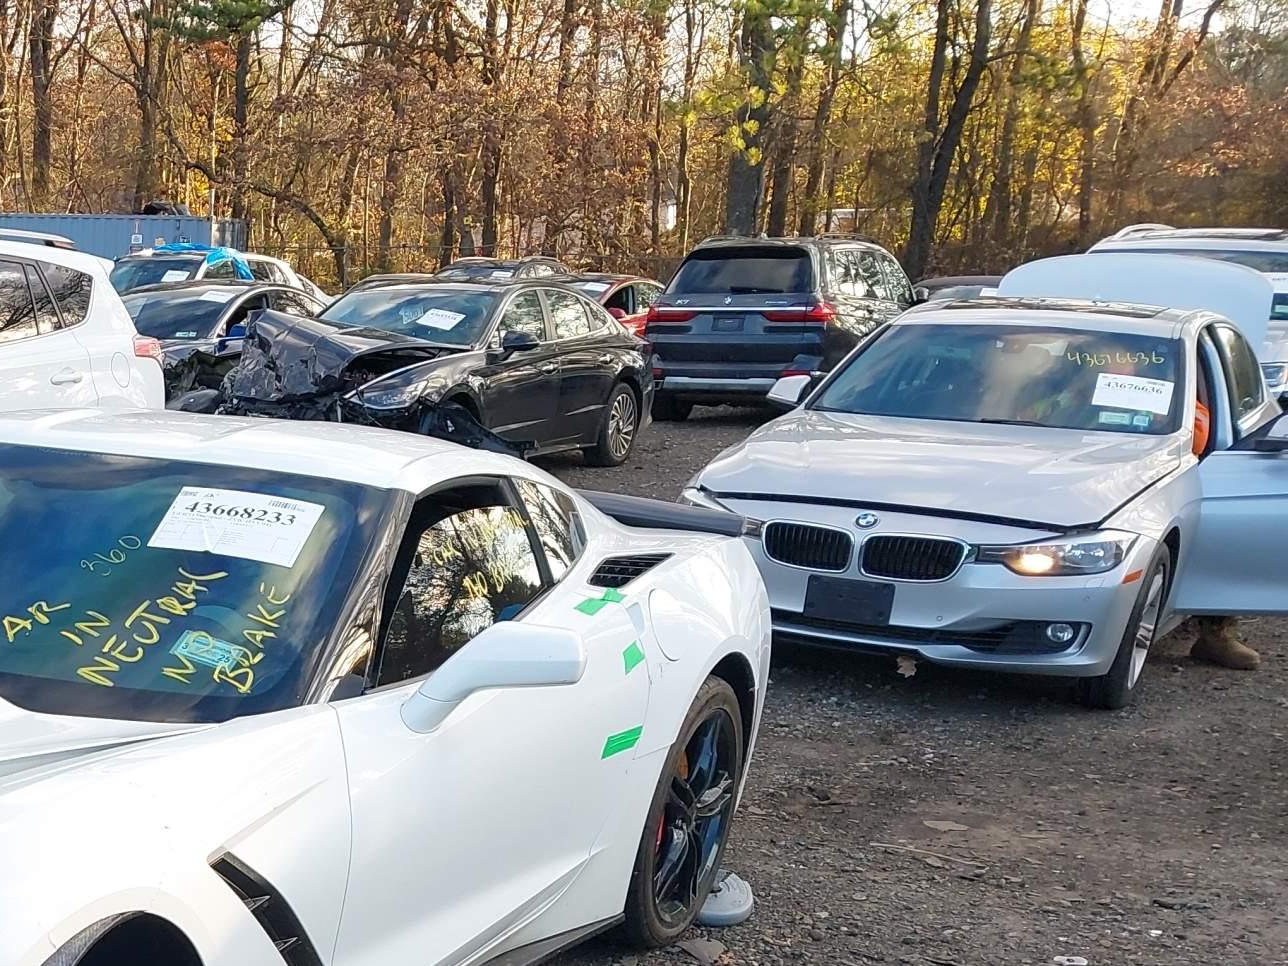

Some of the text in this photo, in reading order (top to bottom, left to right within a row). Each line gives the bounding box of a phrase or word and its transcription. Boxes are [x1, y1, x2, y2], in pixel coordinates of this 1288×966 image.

[1103, 380, 1163, 396] 43676636
[184, 500, 298, 527] 43668233
[80, 535, 142, 577] 360
[59, 609, 112, 646] IN
[76, 566, 230, 687] NEUTRAL
[213, 582, 291, 694] BRAKE
[217, 653, 231, 664] 25
